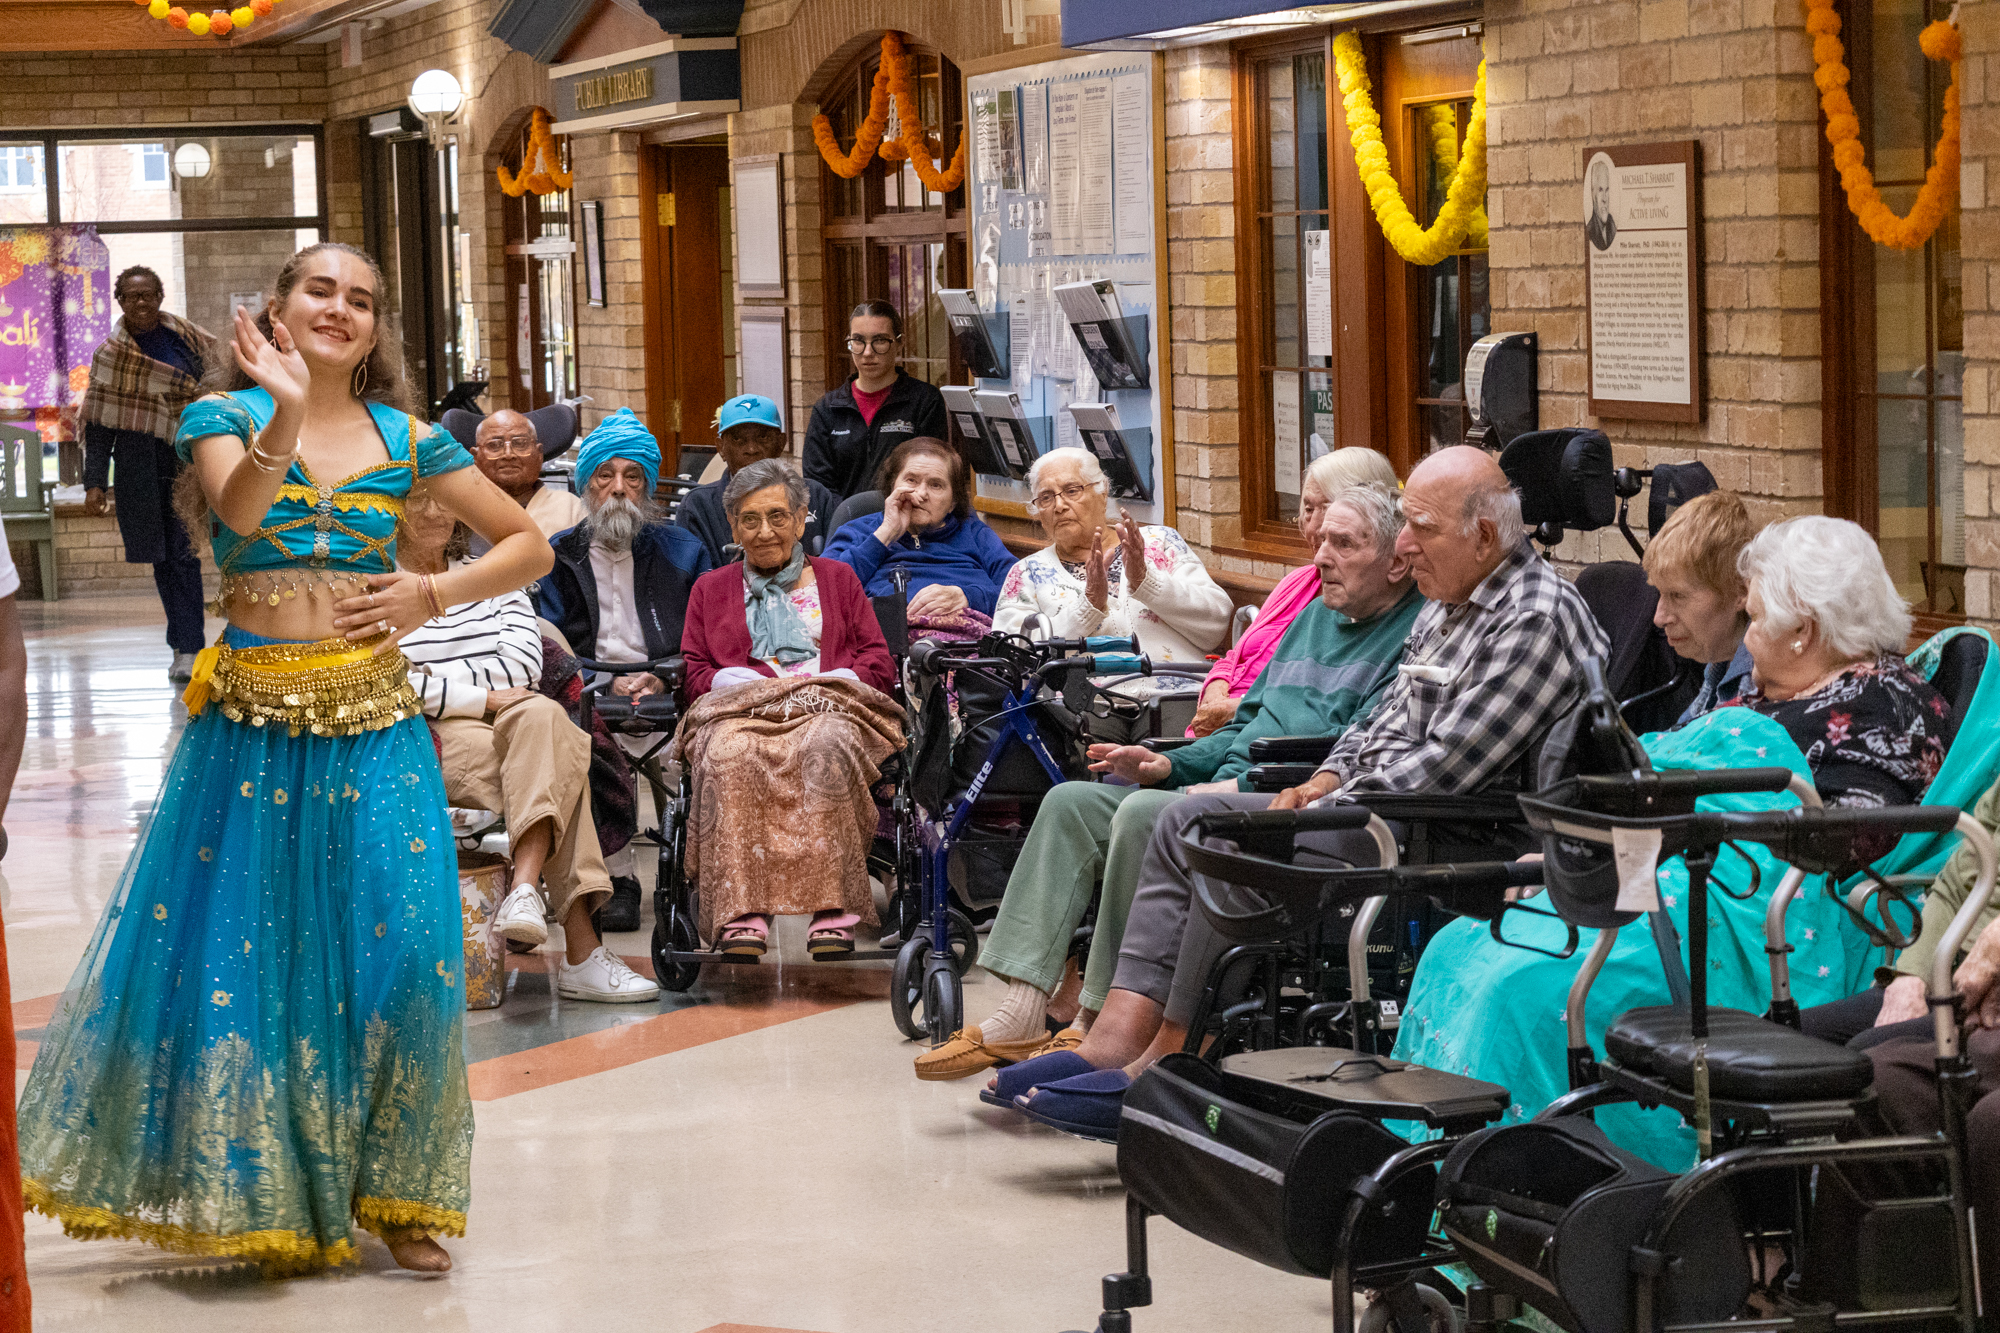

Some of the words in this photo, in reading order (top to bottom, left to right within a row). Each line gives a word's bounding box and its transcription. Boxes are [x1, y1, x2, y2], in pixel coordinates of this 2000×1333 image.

[574, 77, 606, 110] PUBLIC
[608, 67, 647, 104] LIBRARY
[1622, 174, 1644, 184] MICHAEL
[1645, 172, 1650, 183] T.
[1650, 172, 1674, 183] SHARRATT
[1630, 208, 1648, 220] ACTIVE
[1650, 206, 1668, 218] LIVING
[0, 311, 40, 346] ali
[1317, 391, 1332, 411] PAS
[965, 760, 993, 804] Elite
